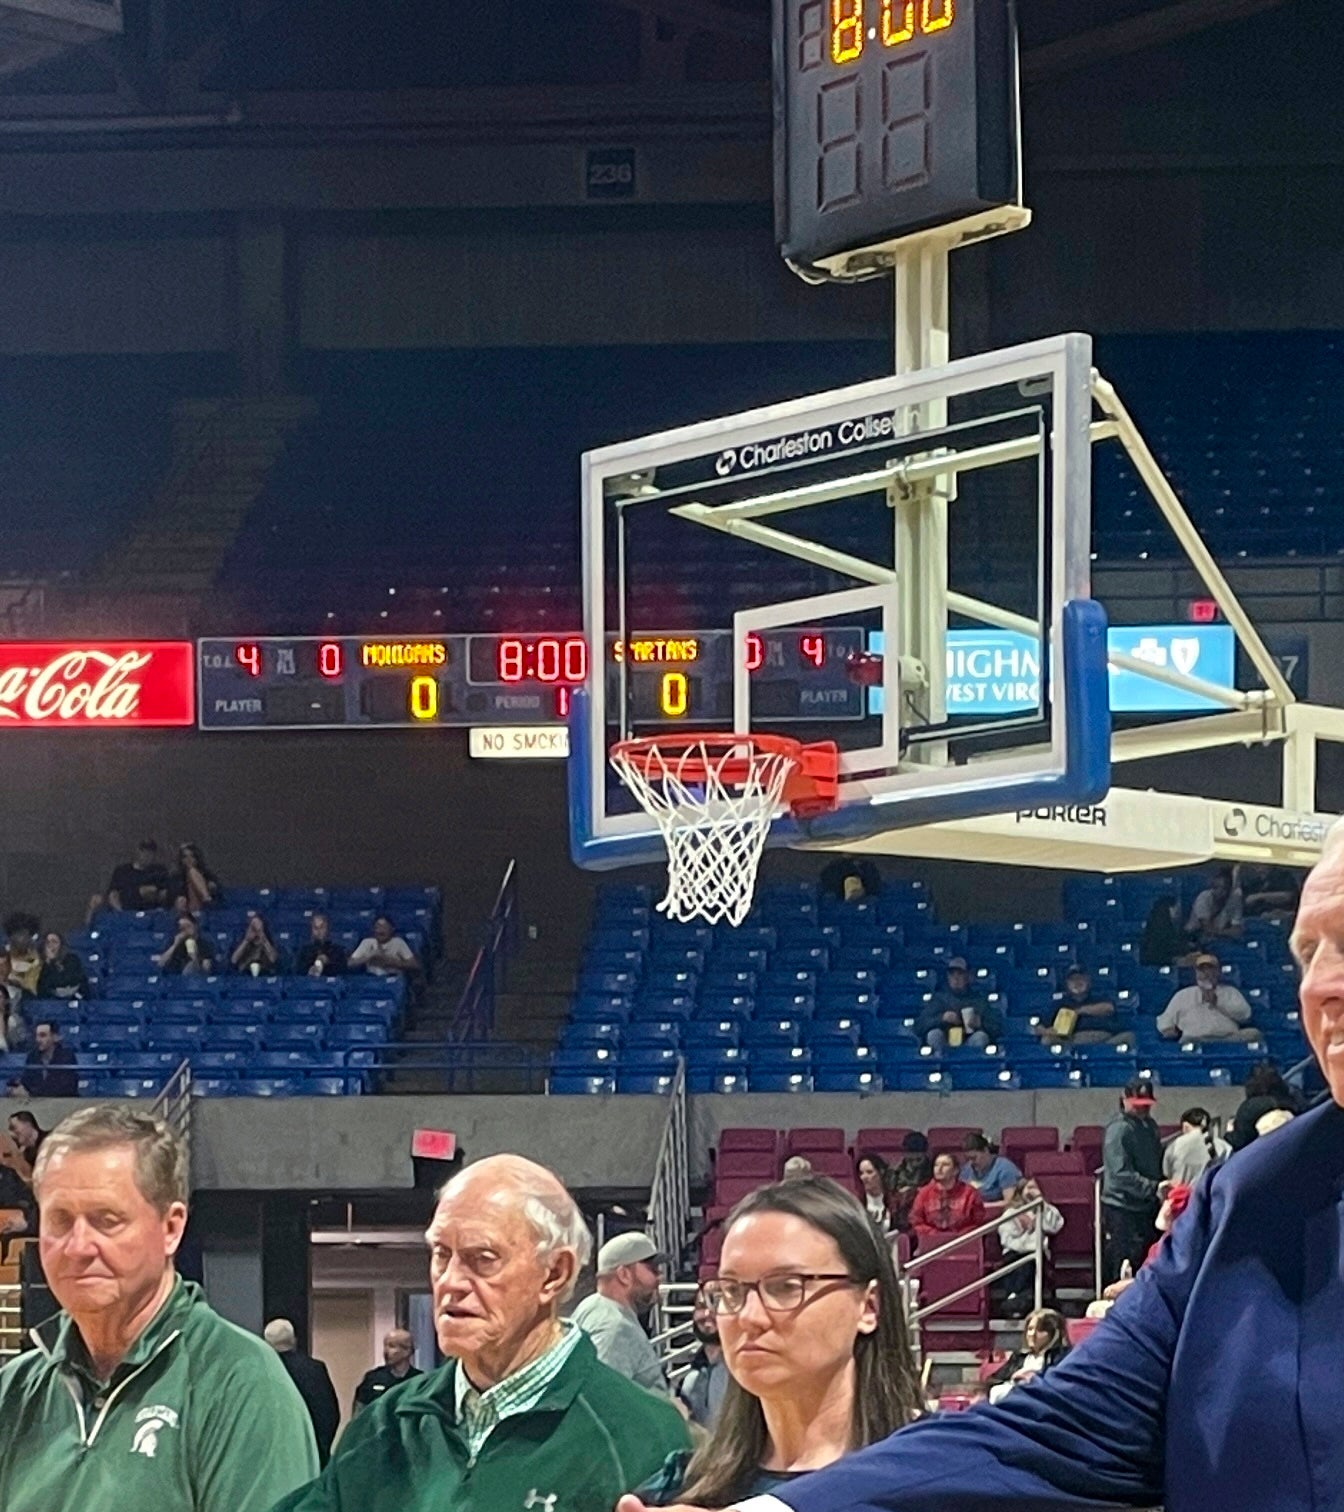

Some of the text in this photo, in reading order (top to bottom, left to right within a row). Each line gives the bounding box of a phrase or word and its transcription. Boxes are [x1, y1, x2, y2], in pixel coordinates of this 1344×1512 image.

[739, 429, 833, 469] Charleston
[237, 646, 260, 676] 4
[320, 643, 341, 676] 0
[500, 640, 587, 681] 8:00
[614, 638, 698, 662] SARTANS
[803, 637, 823, 666] 4
[215, 699, 263, 713] PLAYER
[411, 675, 438, 719] 0
[662, 672, 687, 716] 0
[483, 733, 504, 751] NO
